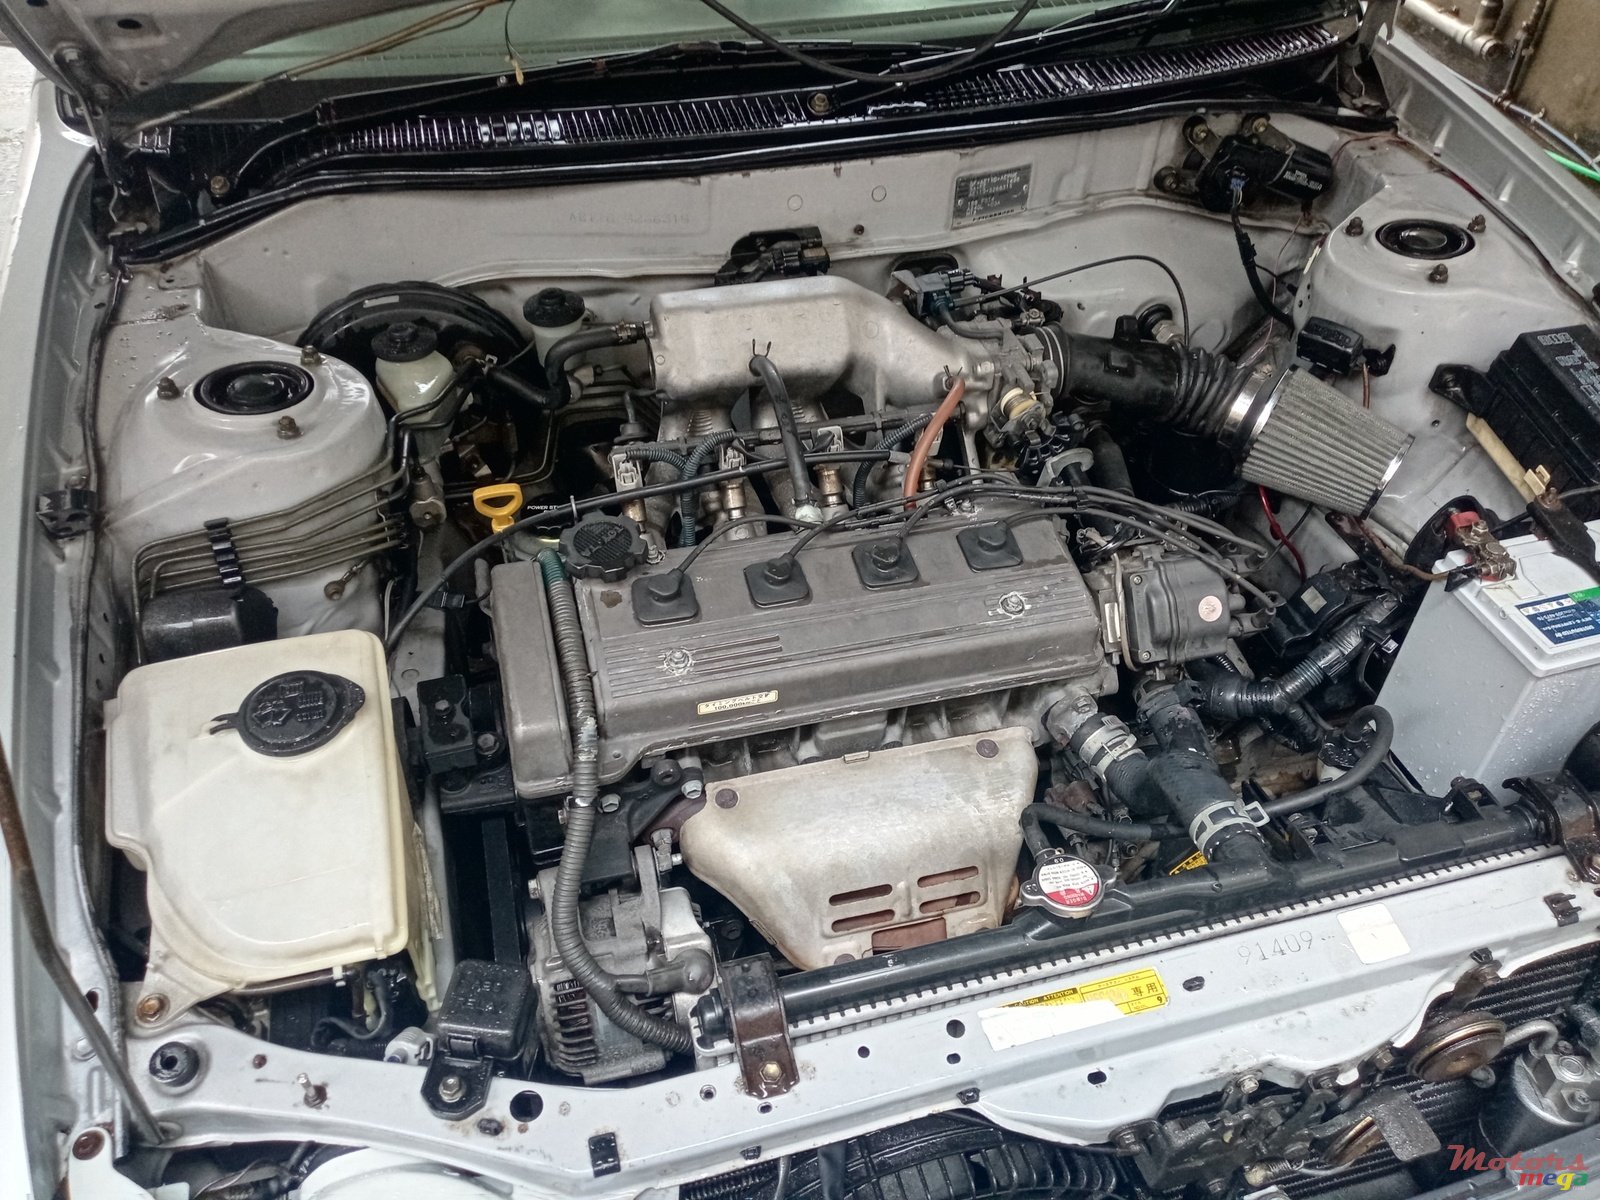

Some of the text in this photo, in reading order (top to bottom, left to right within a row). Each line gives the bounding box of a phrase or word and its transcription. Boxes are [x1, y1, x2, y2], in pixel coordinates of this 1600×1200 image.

[1237, 930, 1313, 966] 91409
[1043, 989, 1074, 1001] ATTENTION
[1131, 982, 1159, 997] 専用
[1156, 995, 1163, 1004] 9
